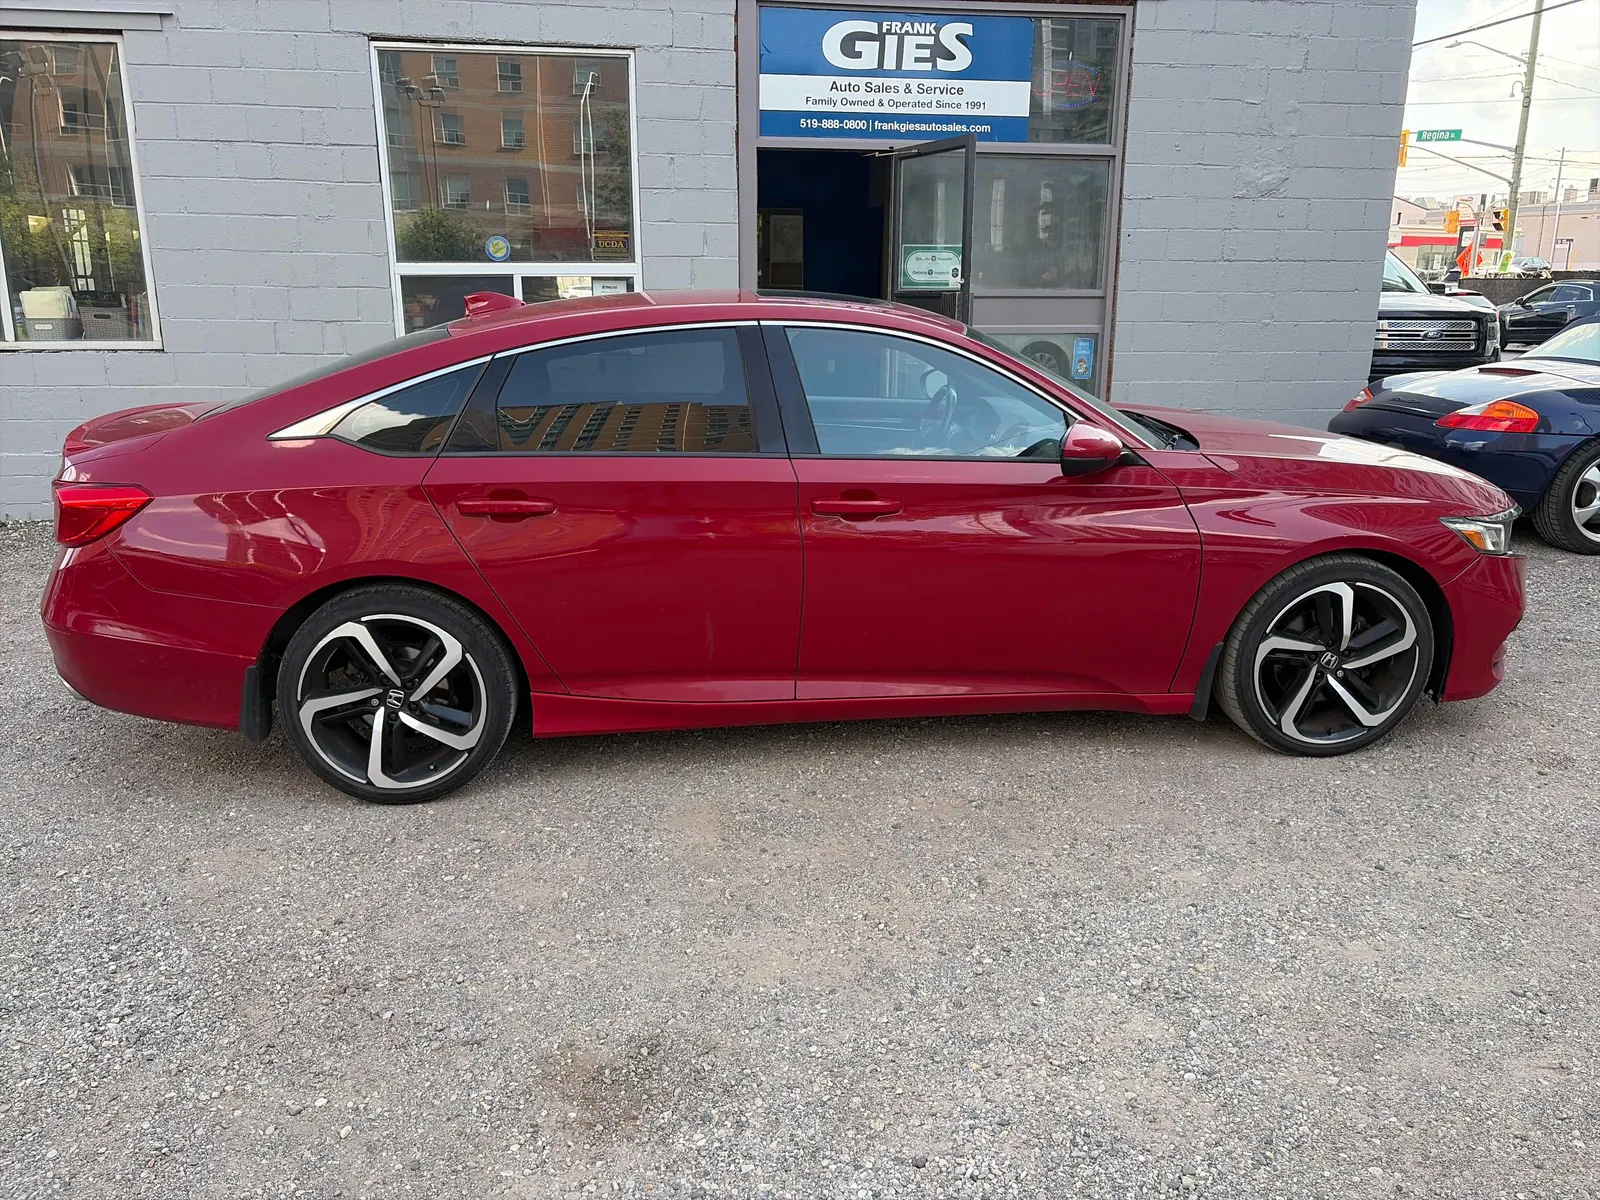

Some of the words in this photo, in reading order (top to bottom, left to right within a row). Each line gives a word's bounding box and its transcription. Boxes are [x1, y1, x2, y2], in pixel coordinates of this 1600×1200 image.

[882, 21, 937, 35] FRANK
[822, 20, 974, 72] GIES
[829, 80, 860, 93] Auto
[864, 81, 900, 94] Sales
[903, 82, 913, 94] &
[916, 83, 964, 96] Service
[805, 96, 838, 108] Family
[840, 97, 875, 107] Owned
[877, 98, 885, 107] &
[887, 98, 933, 109] Operated
[935, 99, 962, 109] Since
[965, 101, 986, 110] 1991
[800, 118, 867, 130] 519-888-0800
[874, 120, 991, 133] frankgiesautosales.com
[1421, 130, 1450, 141] Regina
[598, 240, 624, 248] UCDA
